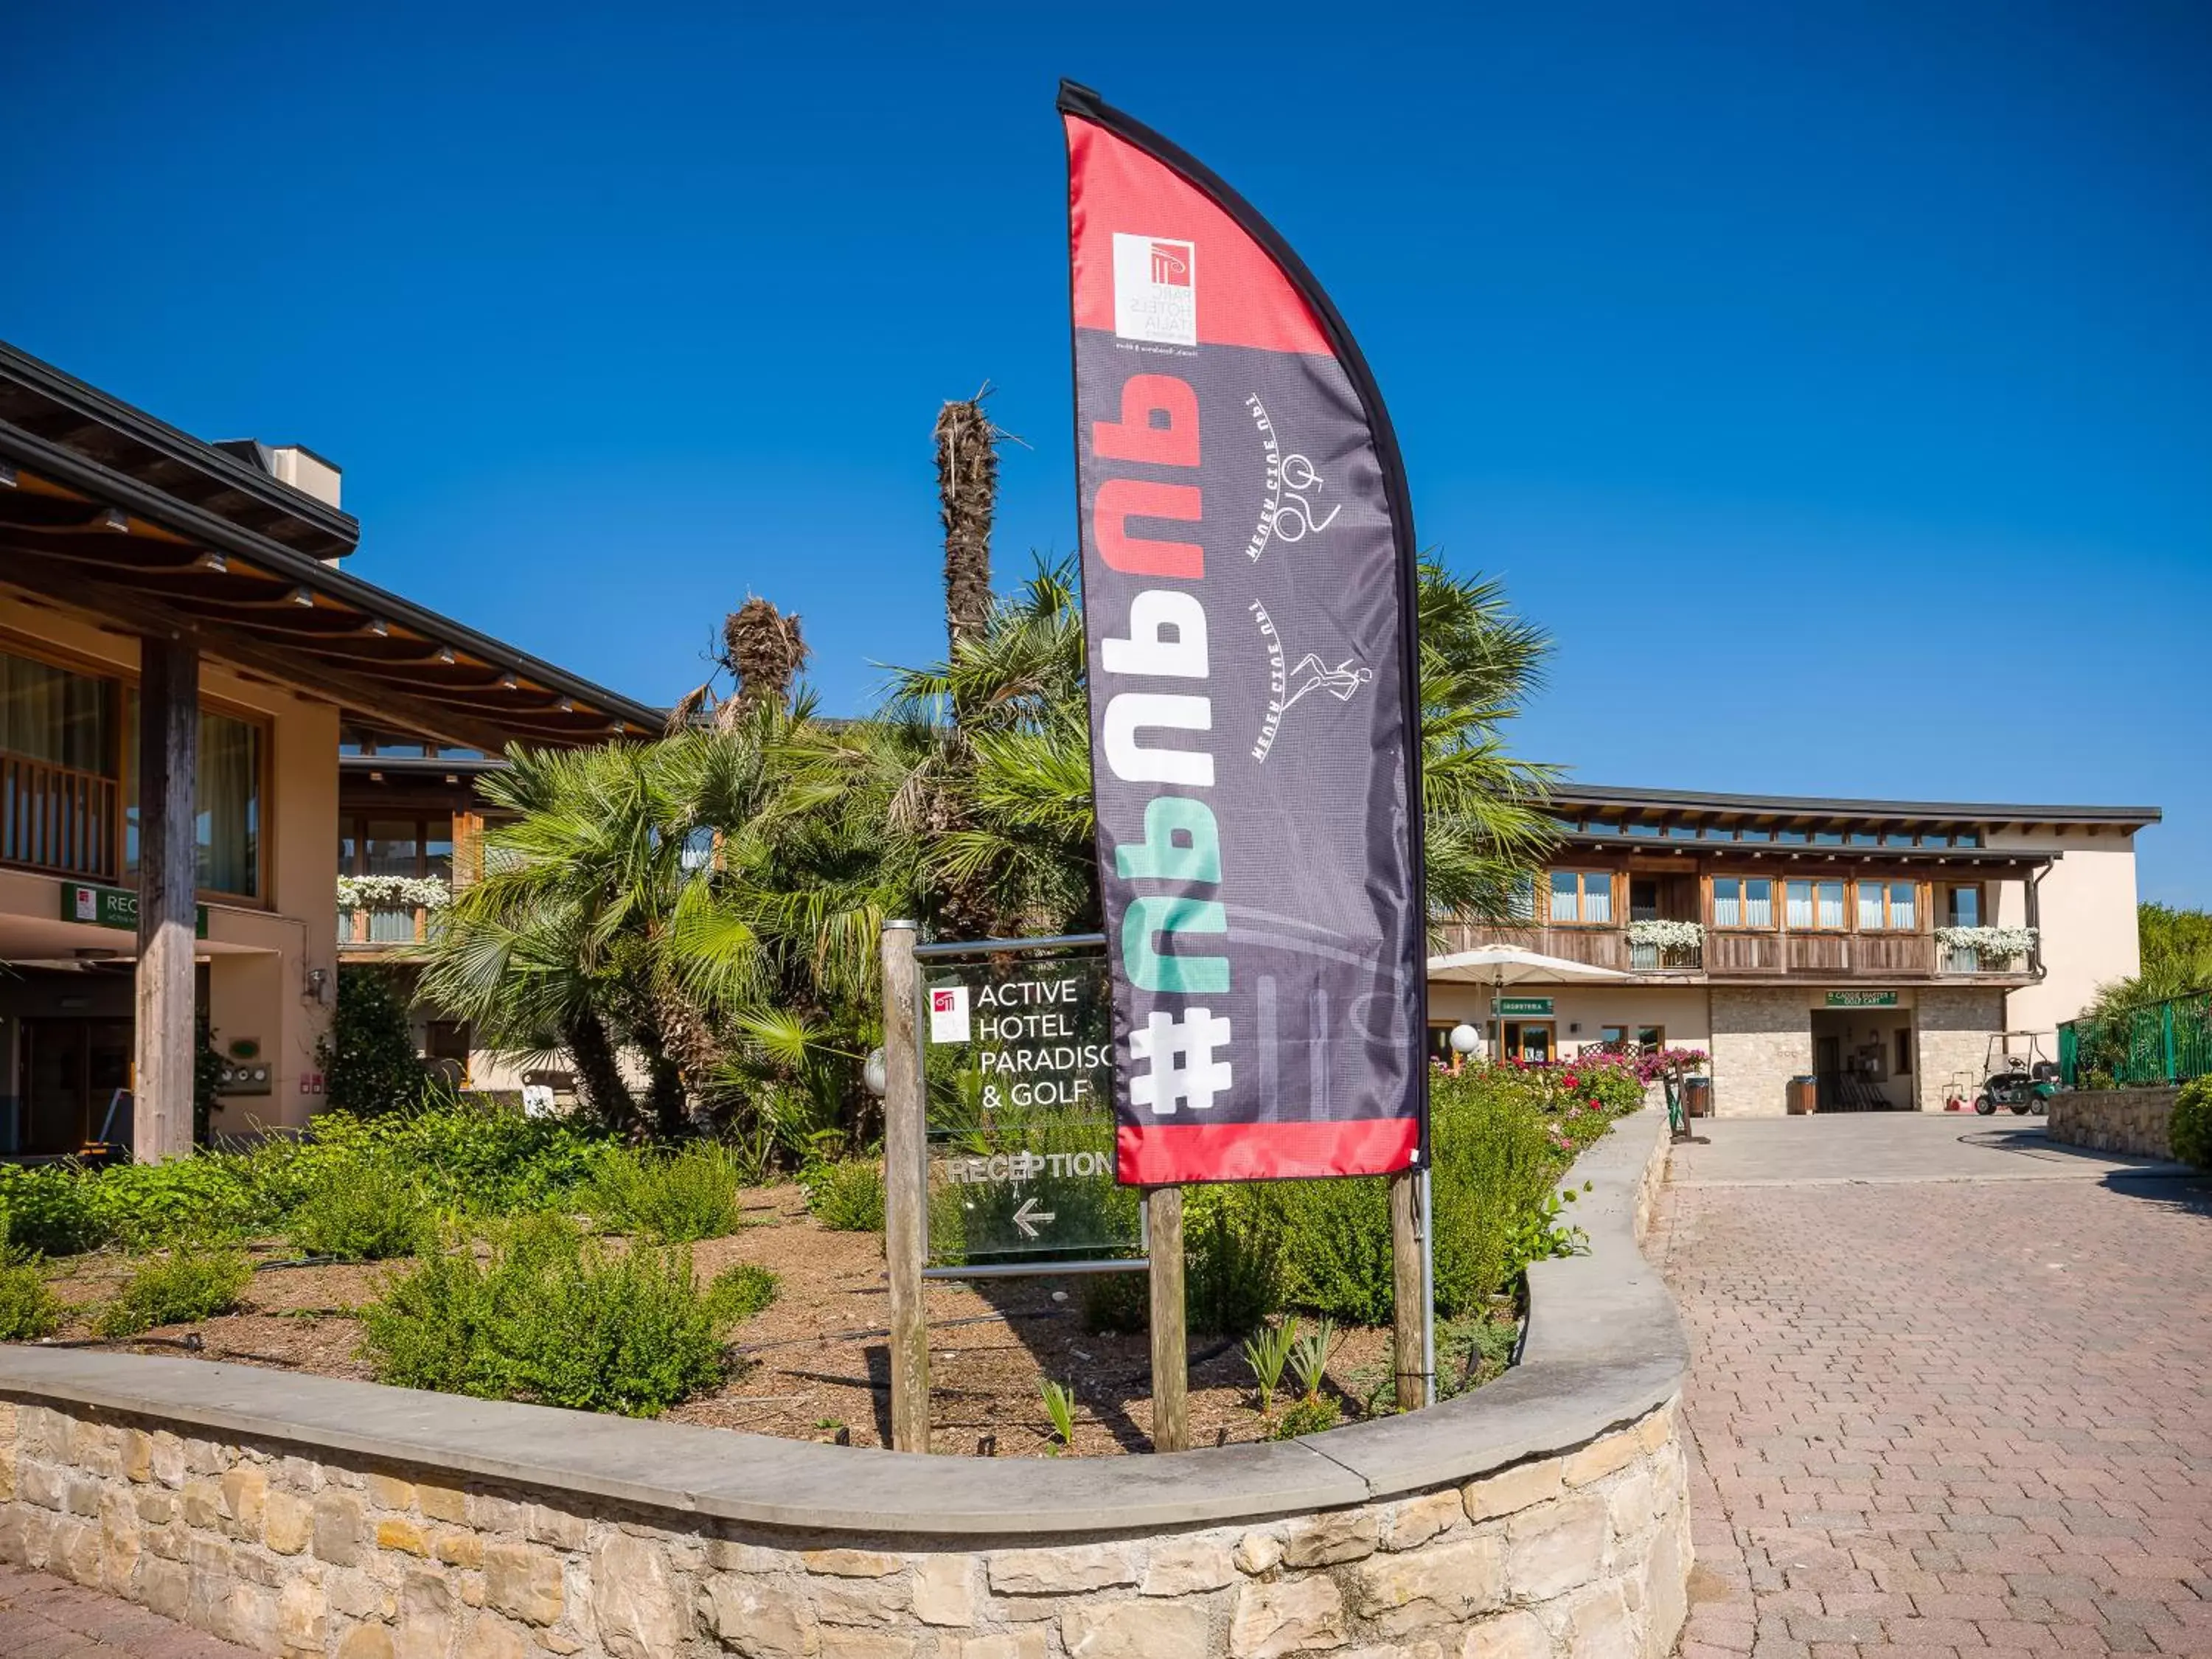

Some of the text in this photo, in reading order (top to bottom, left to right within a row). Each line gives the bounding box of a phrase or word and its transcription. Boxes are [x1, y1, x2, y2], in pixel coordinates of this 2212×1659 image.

[977, 980, 1078, 1008] ACTIVE
[979, 1014, 1074, 1041] HOTEL
[983, 1079, 1088, 1107] & GOLF
[947, 1151, 1114, 1183] RECEPTION
